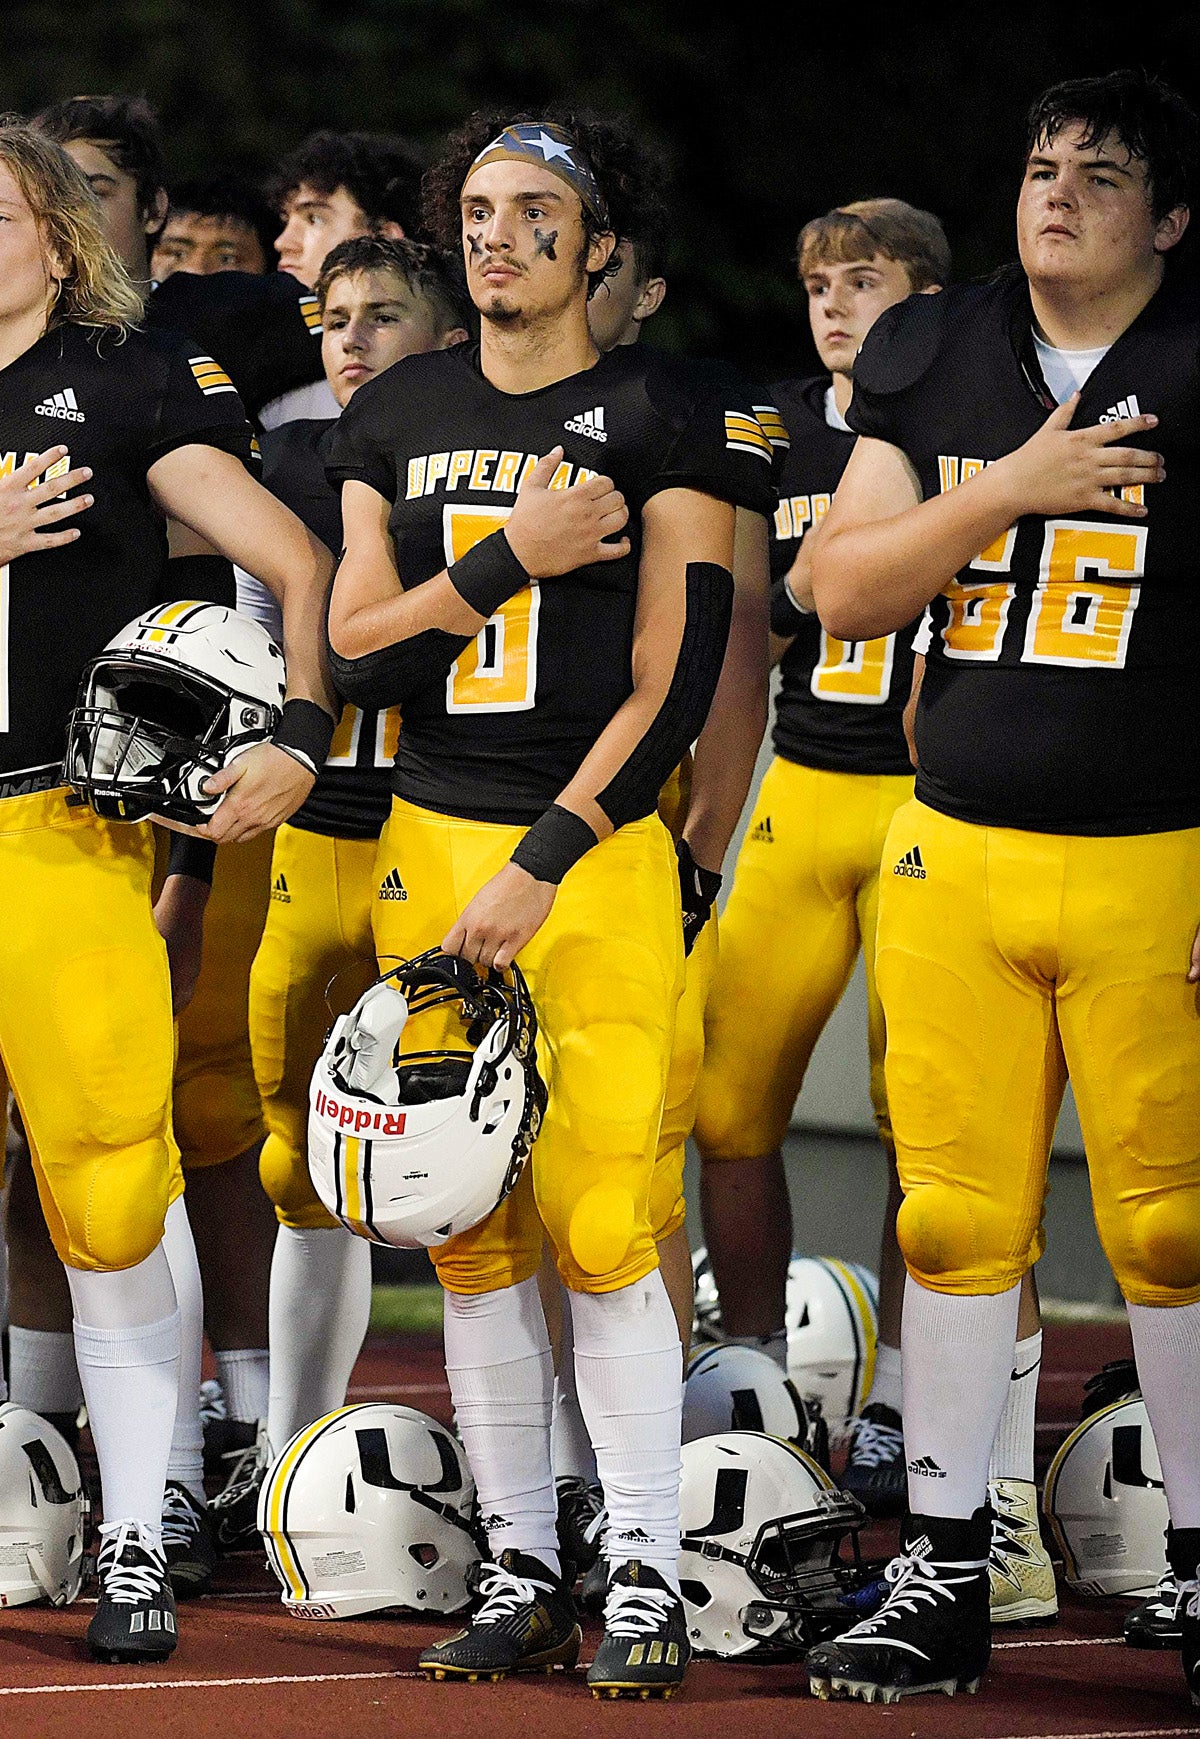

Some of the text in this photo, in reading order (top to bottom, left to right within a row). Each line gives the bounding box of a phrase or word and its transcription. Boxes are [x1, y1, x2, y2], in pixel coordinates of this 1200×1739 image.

[35, 403, 86, 423] adidas
[563, 418, 608, 443] adidas
[773, 492, 836, 540] UPP
[939, 518, 1149, 669] 66
[893, 863, 927, 880] adidas
[315, 1089, 407, 1136] Riddell
[355, 1427, 463, 1494] U
[907, 1464, 947, 1479] adidas
